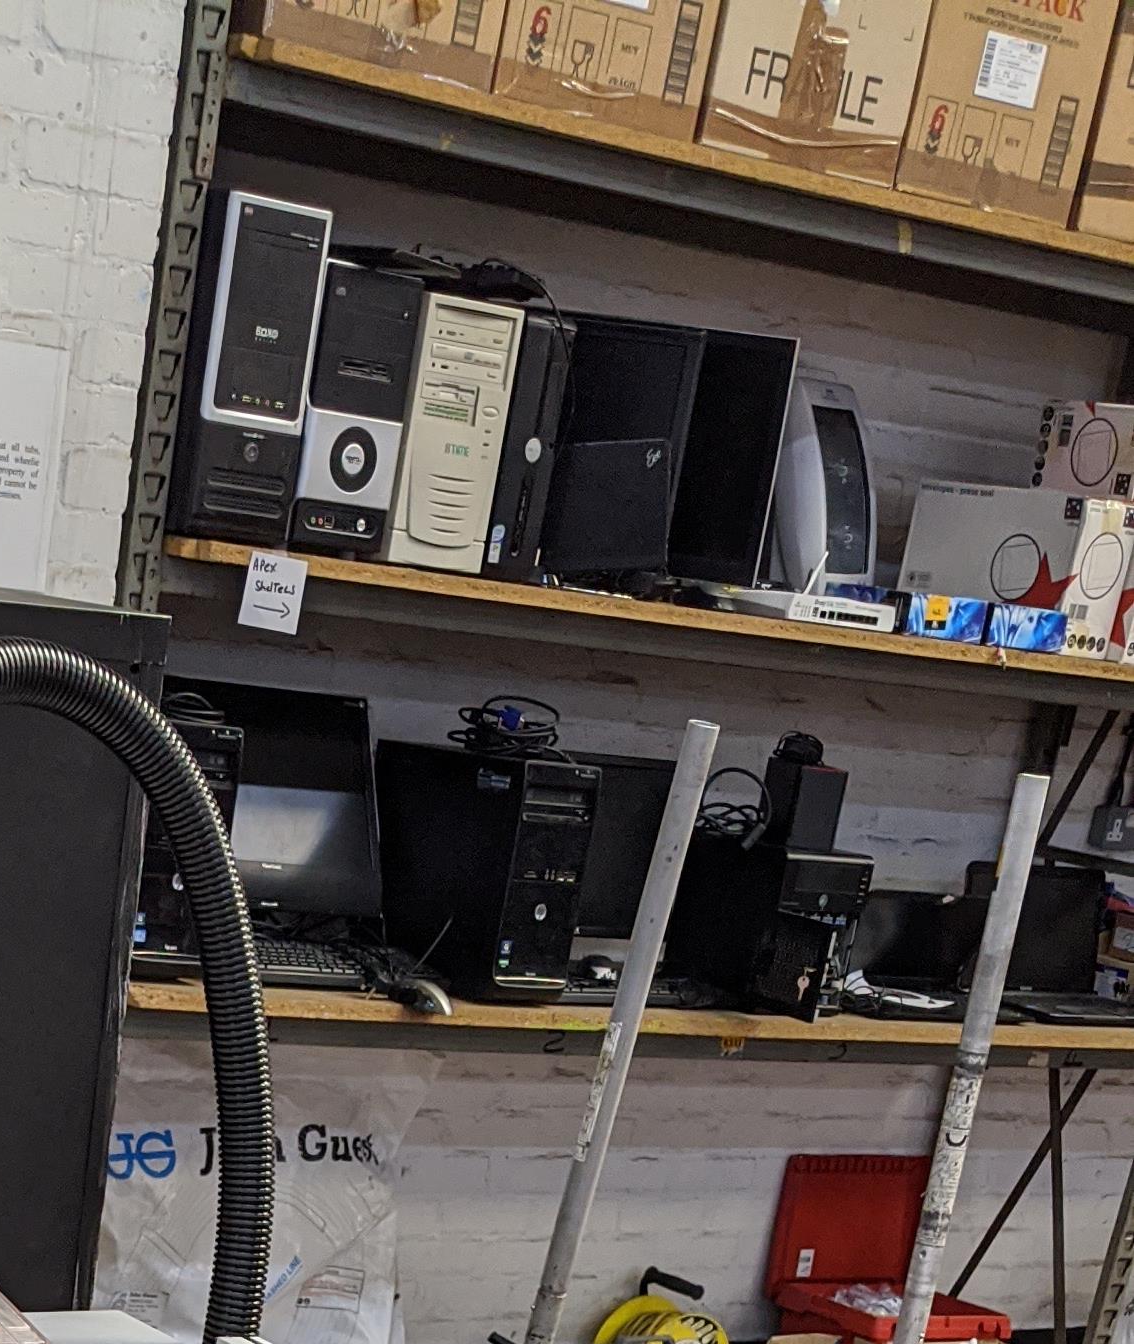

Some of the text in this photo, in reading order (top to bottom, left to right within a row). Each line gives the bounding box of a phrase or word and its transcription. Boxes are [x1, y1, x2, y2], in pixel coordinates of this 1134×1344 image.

[11, 443, 20, 452] all
[30, 469, 39, 478] of
[4, 479, 26, 488] cannot
[28, 480, 37, 490] be
